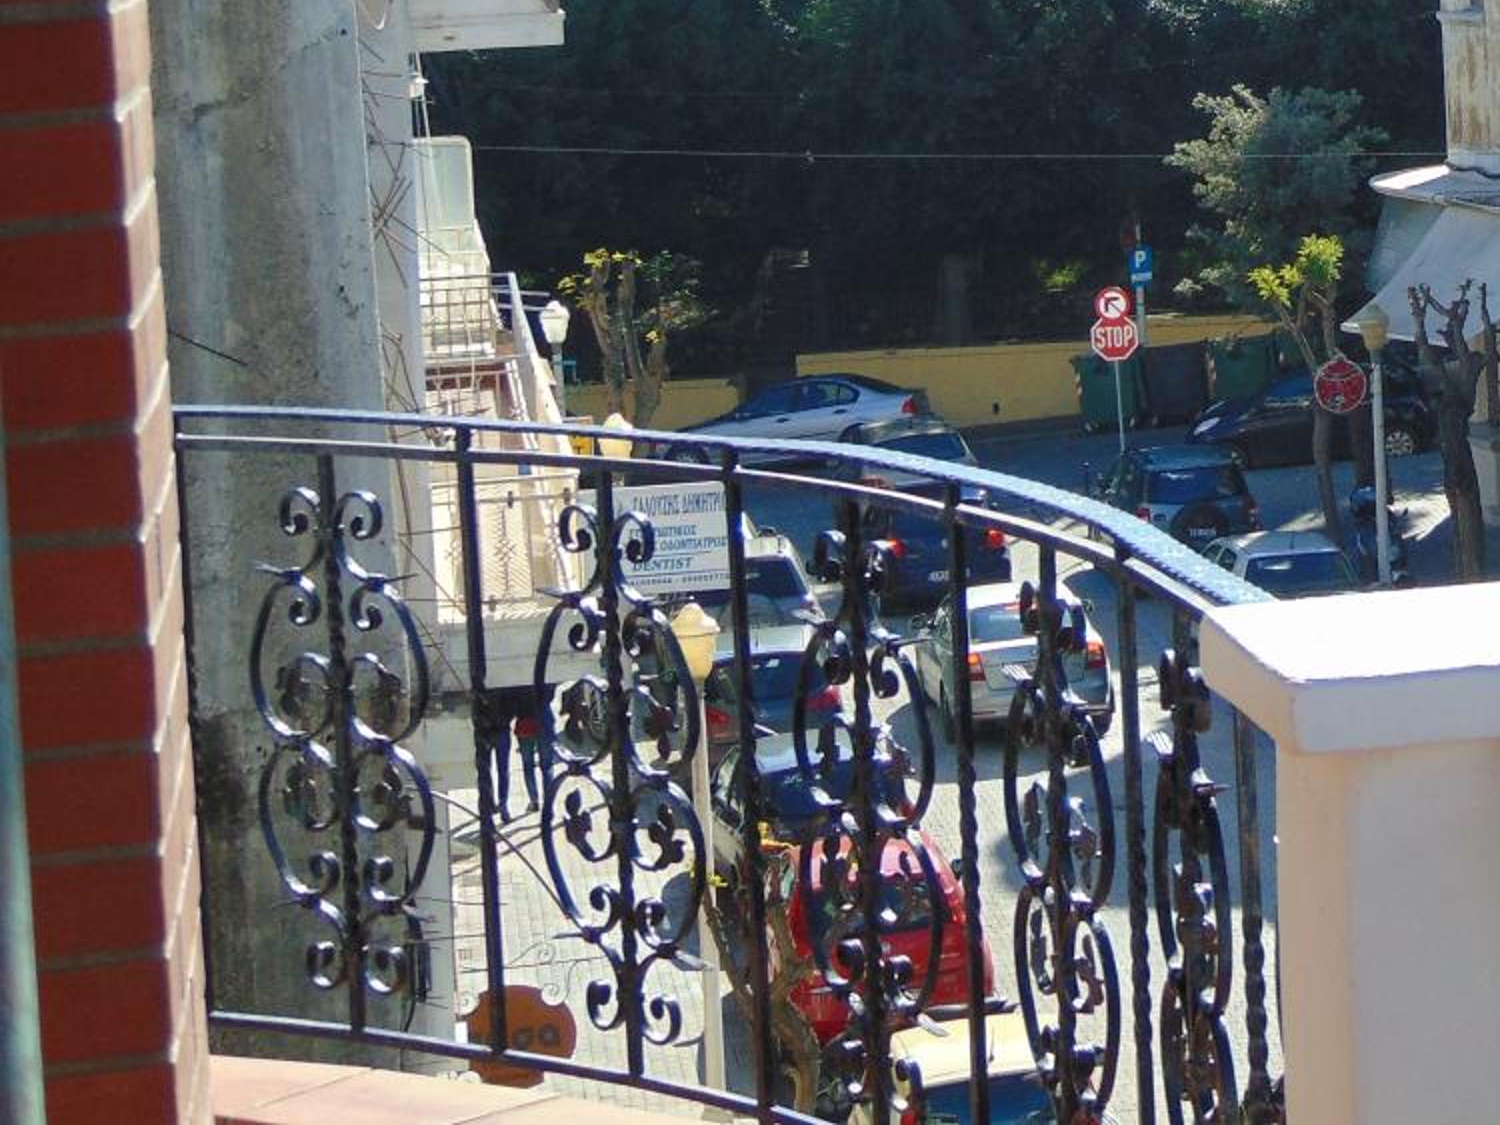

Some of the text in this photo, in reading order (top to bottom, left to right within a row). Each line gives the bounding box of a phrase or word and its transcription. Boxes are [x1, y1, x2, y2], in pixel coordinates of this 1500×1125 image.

[1134, 250, 1147, 269] P
[1095, 326, 1133, 350] STOP
[633, 556, 693, 572] DENTIST
